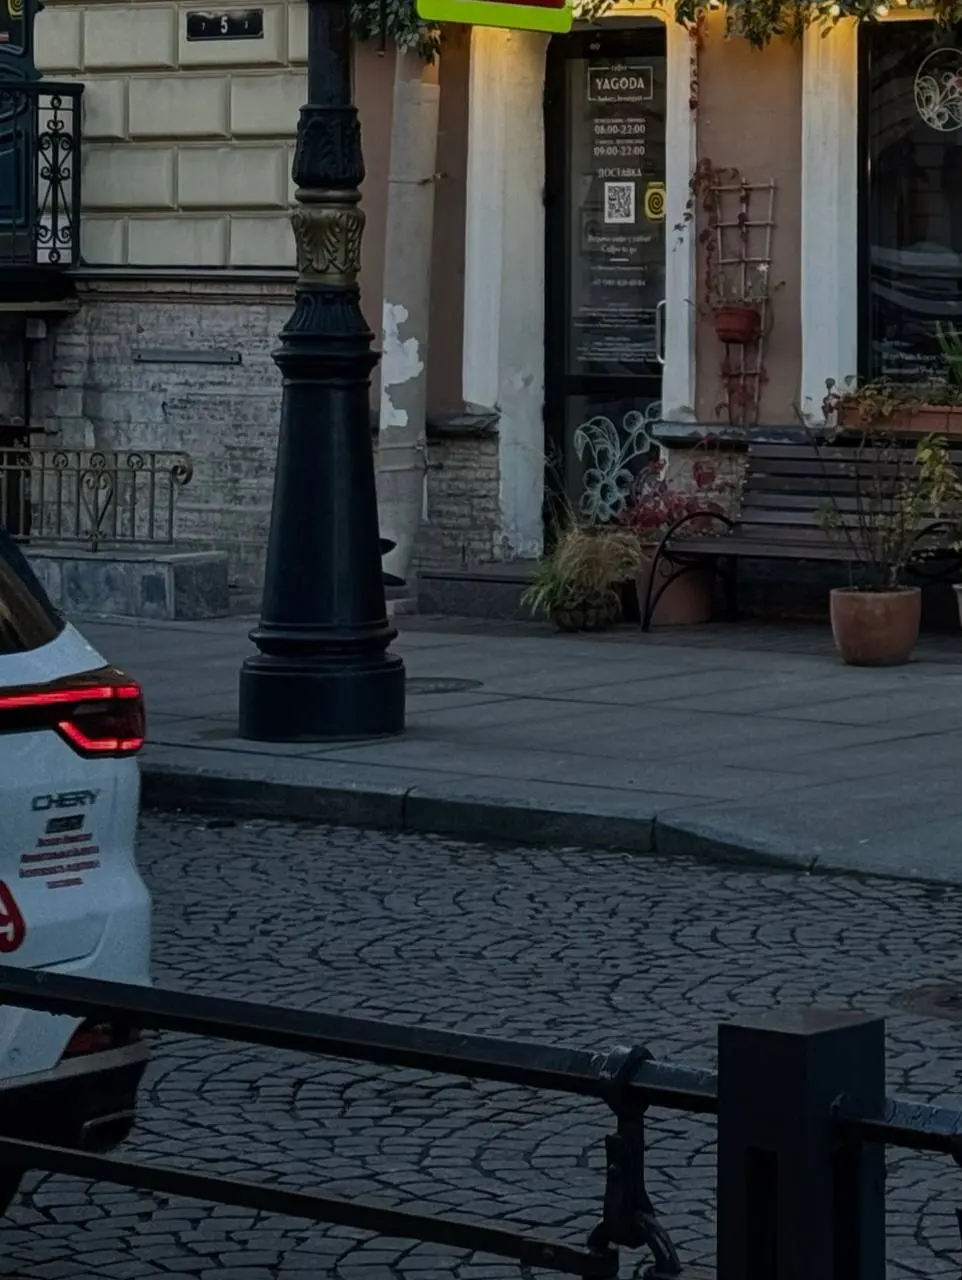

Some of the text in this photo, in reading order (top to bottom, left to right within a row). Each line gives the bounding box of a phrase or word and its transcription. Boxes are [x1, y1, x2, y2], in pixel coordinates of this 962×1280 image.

[220, 15, 229, 34] 5
[595, 76, 645, 90] YAGODA
[32, 788, 101, 812] CHERY
